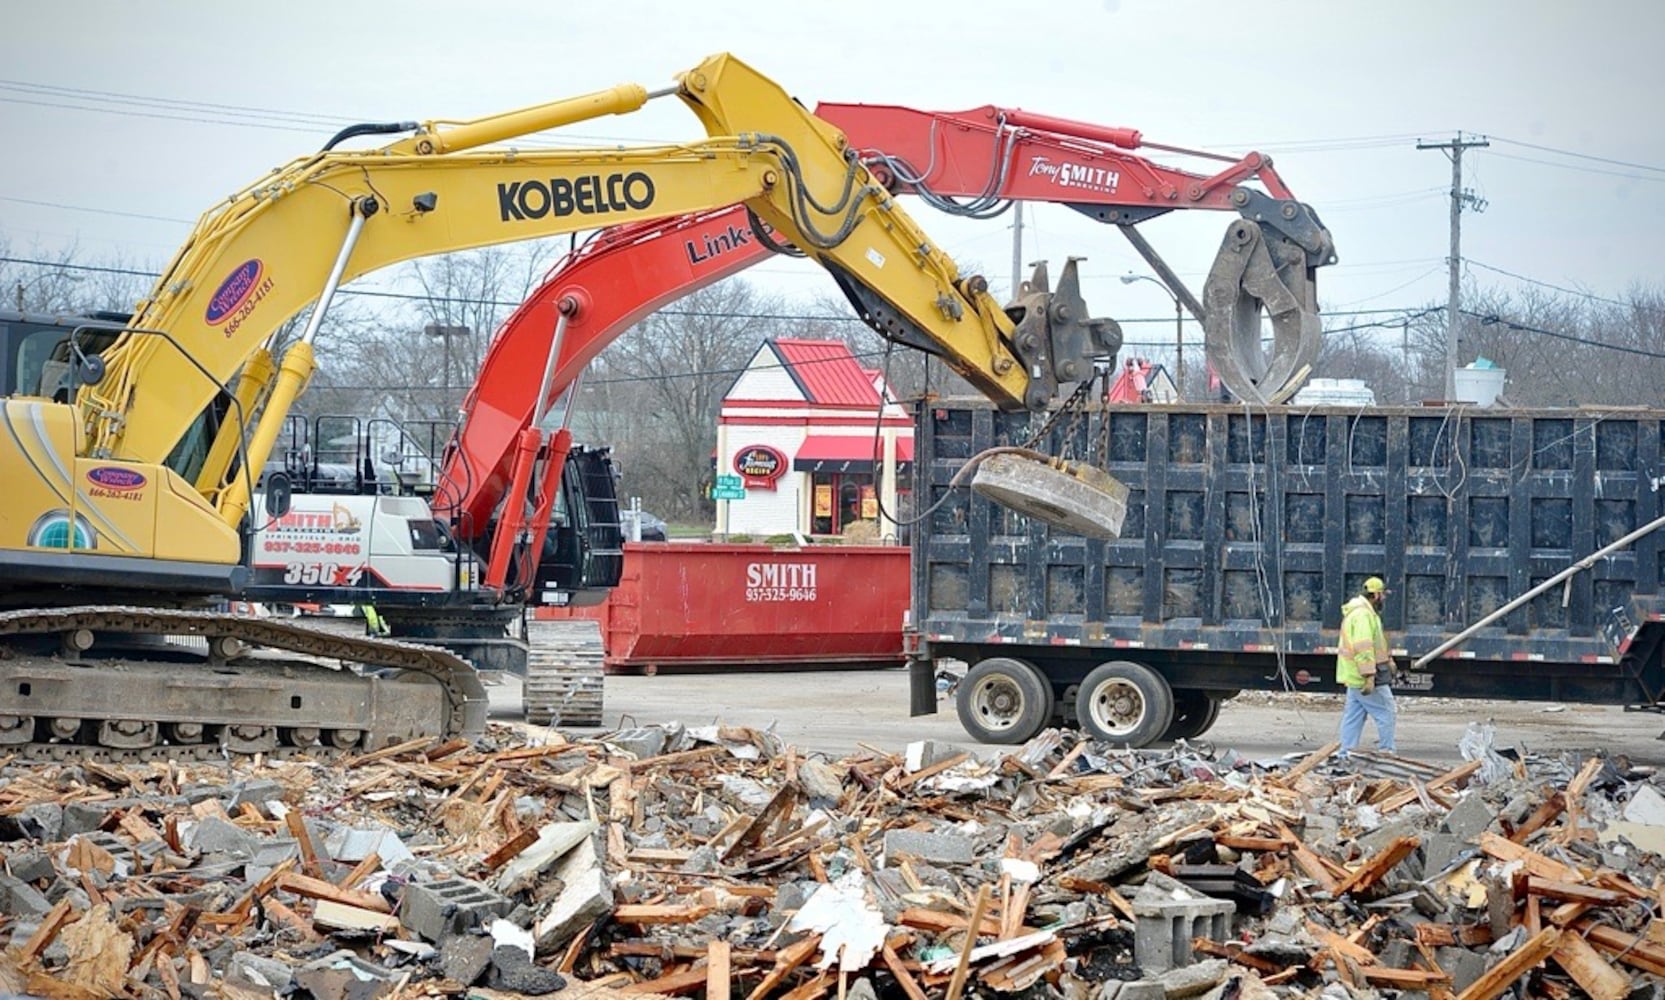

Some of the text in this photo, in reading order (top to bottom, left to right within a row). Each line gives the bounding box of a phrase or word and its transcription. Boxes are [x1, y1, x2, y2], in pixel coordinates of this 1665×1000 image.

[1060, 163, 1119, 188] SMITH
[497, 171, 656, 222] KOBELCO
[224, 277, 274, 338] 866-262-4181
[746, 563, 817, 588] SMITH
